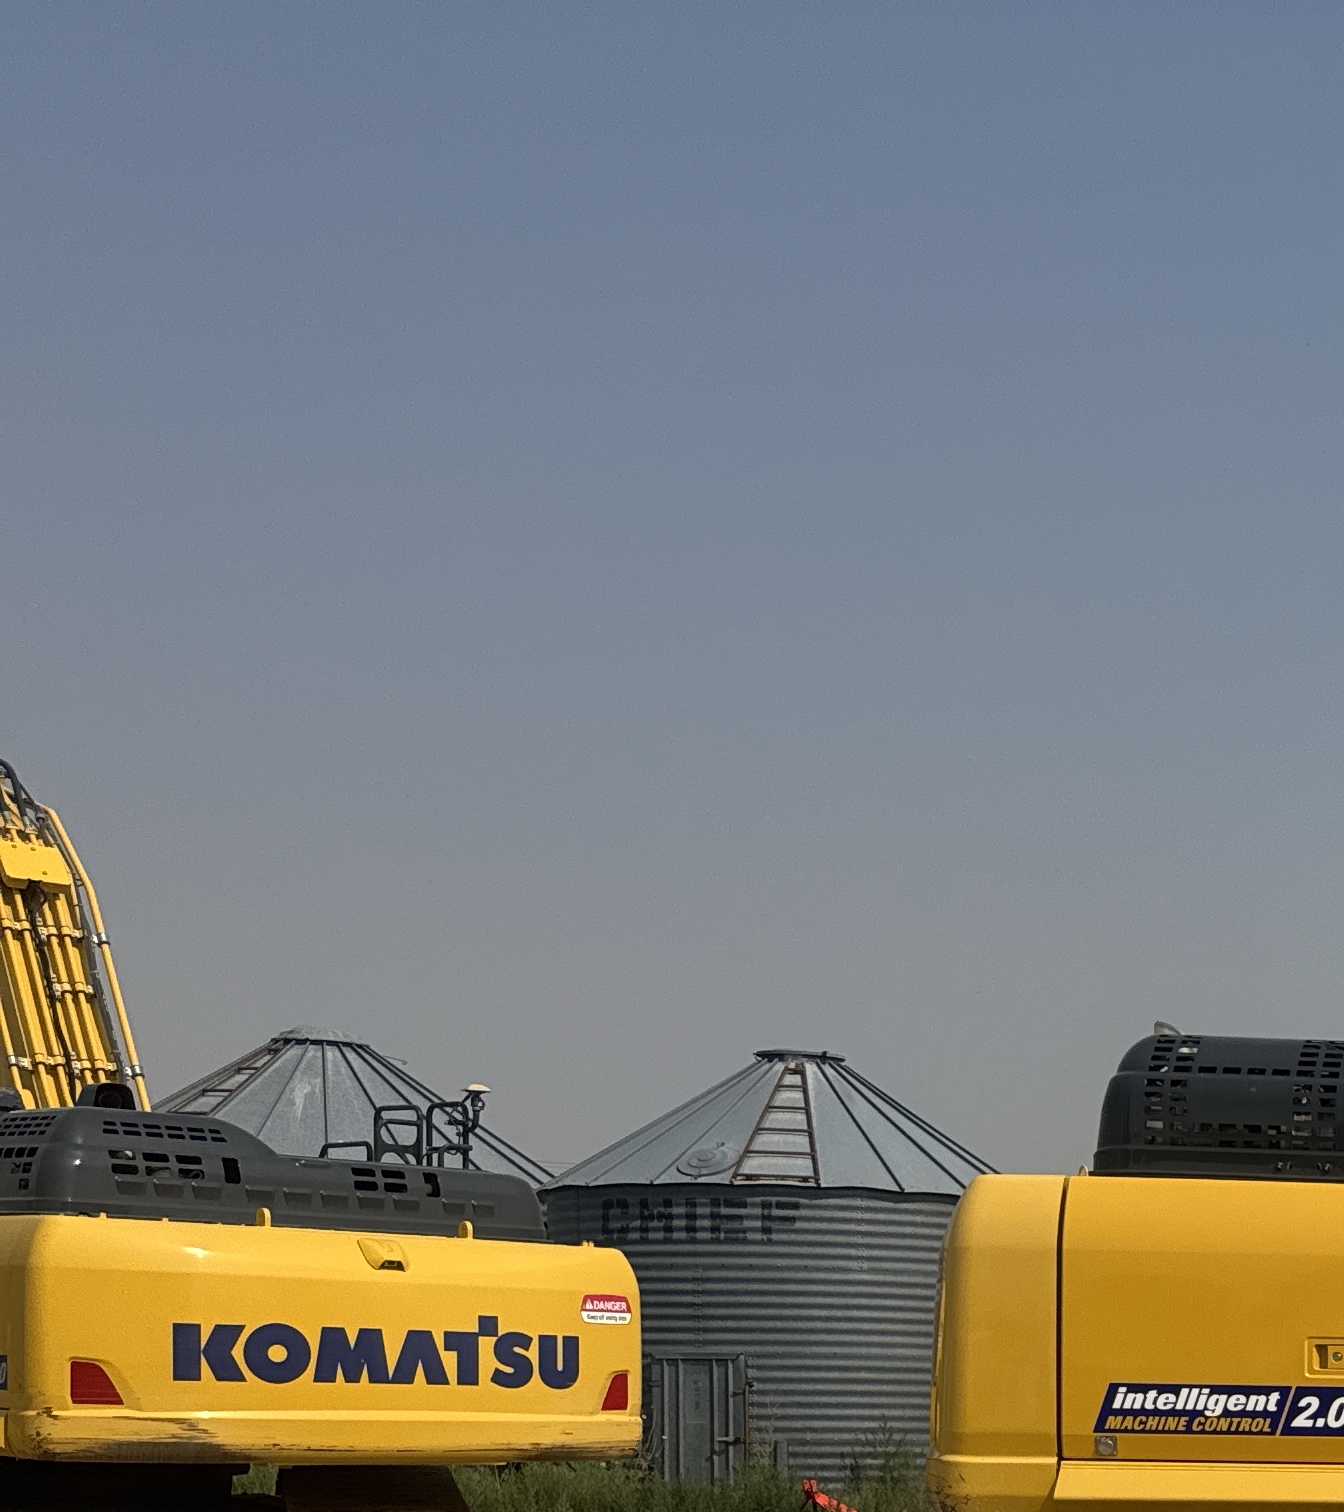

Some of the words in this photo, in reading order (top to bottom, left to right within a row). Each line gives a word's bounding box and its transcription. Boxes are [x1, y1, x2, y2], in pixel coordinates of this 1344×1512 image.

[602, 1198, 800, 1242] CHIEF
[593, 1300, 627, 1311] DANGER
[172, 1315, 580, 1390] KOMATSU
[1111, 1386, 1281, 1417] intelligent
[1104, 1415, 1189, 1431] MACHINE
[1192, 1416, 1272, 1432] CONTROL
